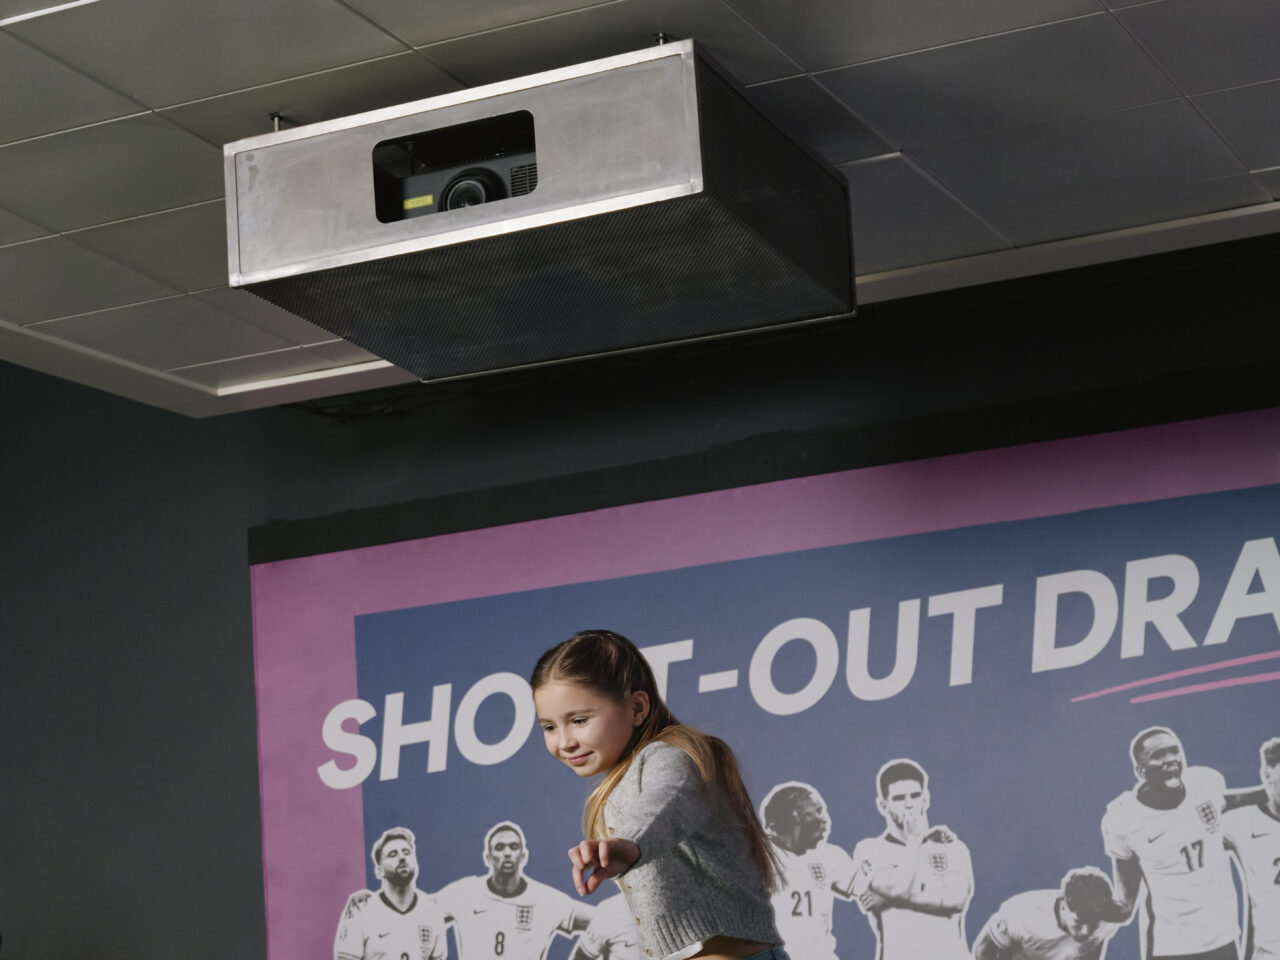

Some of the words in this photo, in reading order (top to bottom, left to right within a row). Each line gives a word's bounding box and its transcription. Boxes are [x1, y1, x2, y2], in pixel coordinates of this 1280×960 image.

[317, 583, 1003, 789] SHOT-OUT
[1179, 840, 1204, 872] 17
[791, 890, 813, 917] 21
[494, 931, 505, 956] 8
